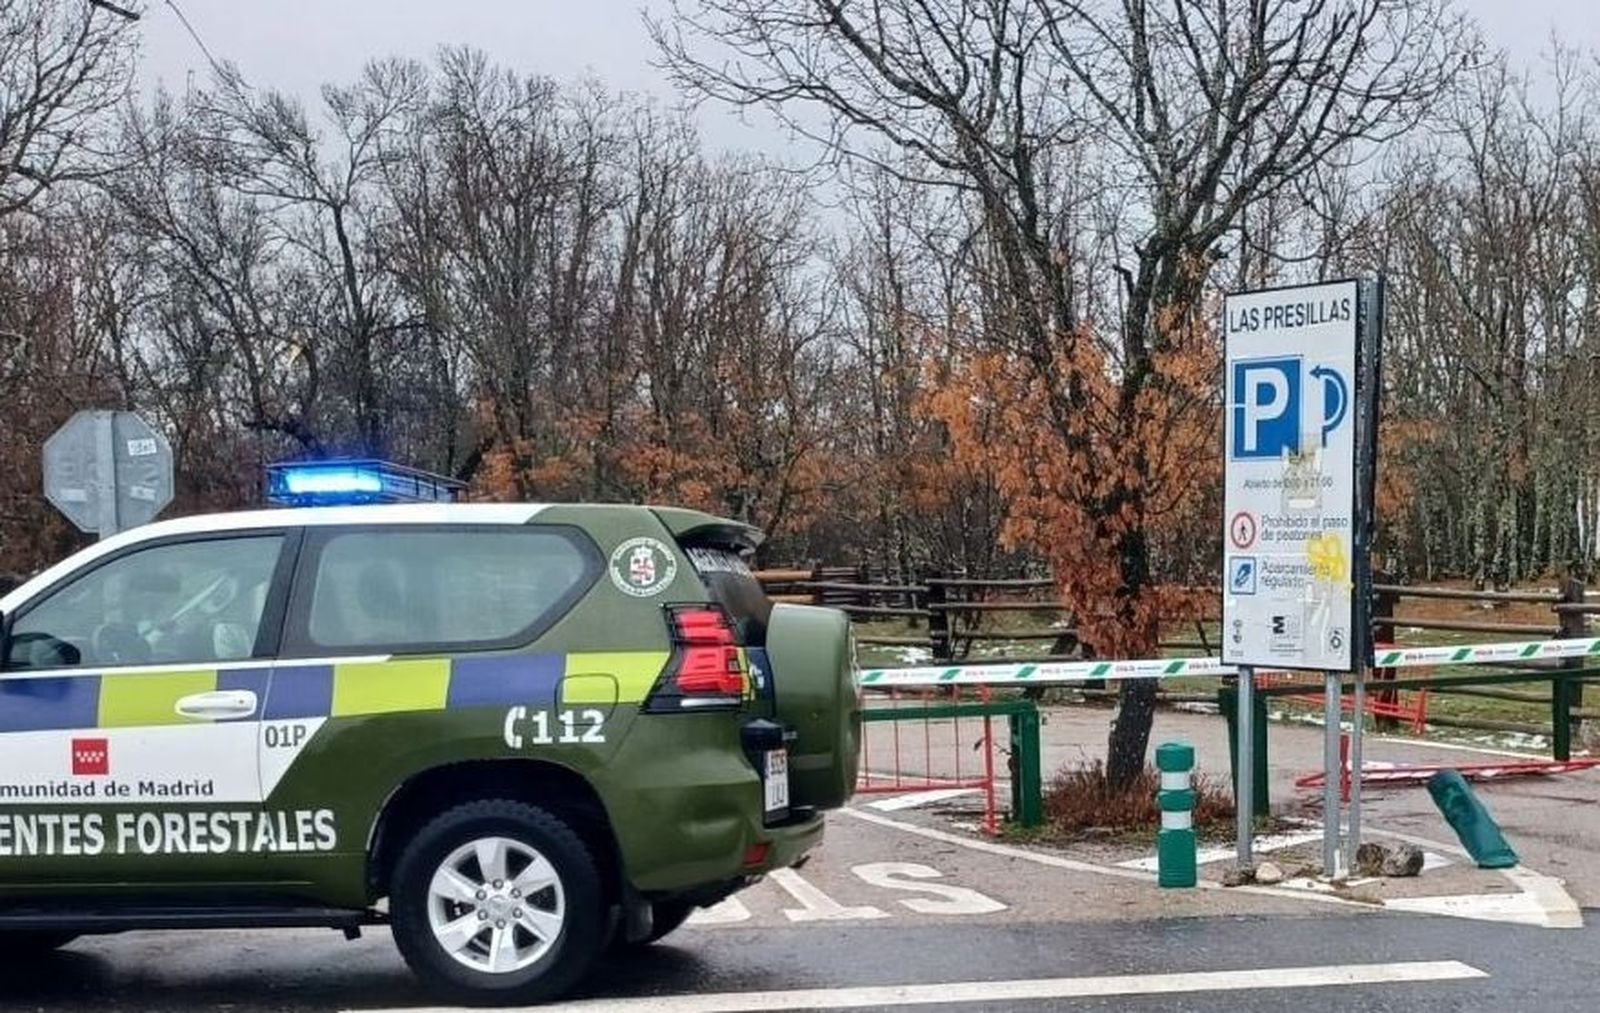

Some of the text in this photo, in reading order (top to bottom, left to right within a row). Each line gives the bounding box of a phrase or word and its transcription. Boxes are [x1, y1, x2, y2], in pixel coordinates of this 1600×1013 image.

[1230, 298, 1351, 333] LAS PRESILLAS
[1244, 367, 1289, 452] P
[1261, 513, 1349, 531] Prohibido el paso
[1261, 528, 1323, 544] de peatones
[264, 724, 307, 748] 01P
[532, 709, 607, 744] 112
[0, 780, 214, 797] munidad de Madrid
[0, 808, 337, 855] ENTES FORESTALES
